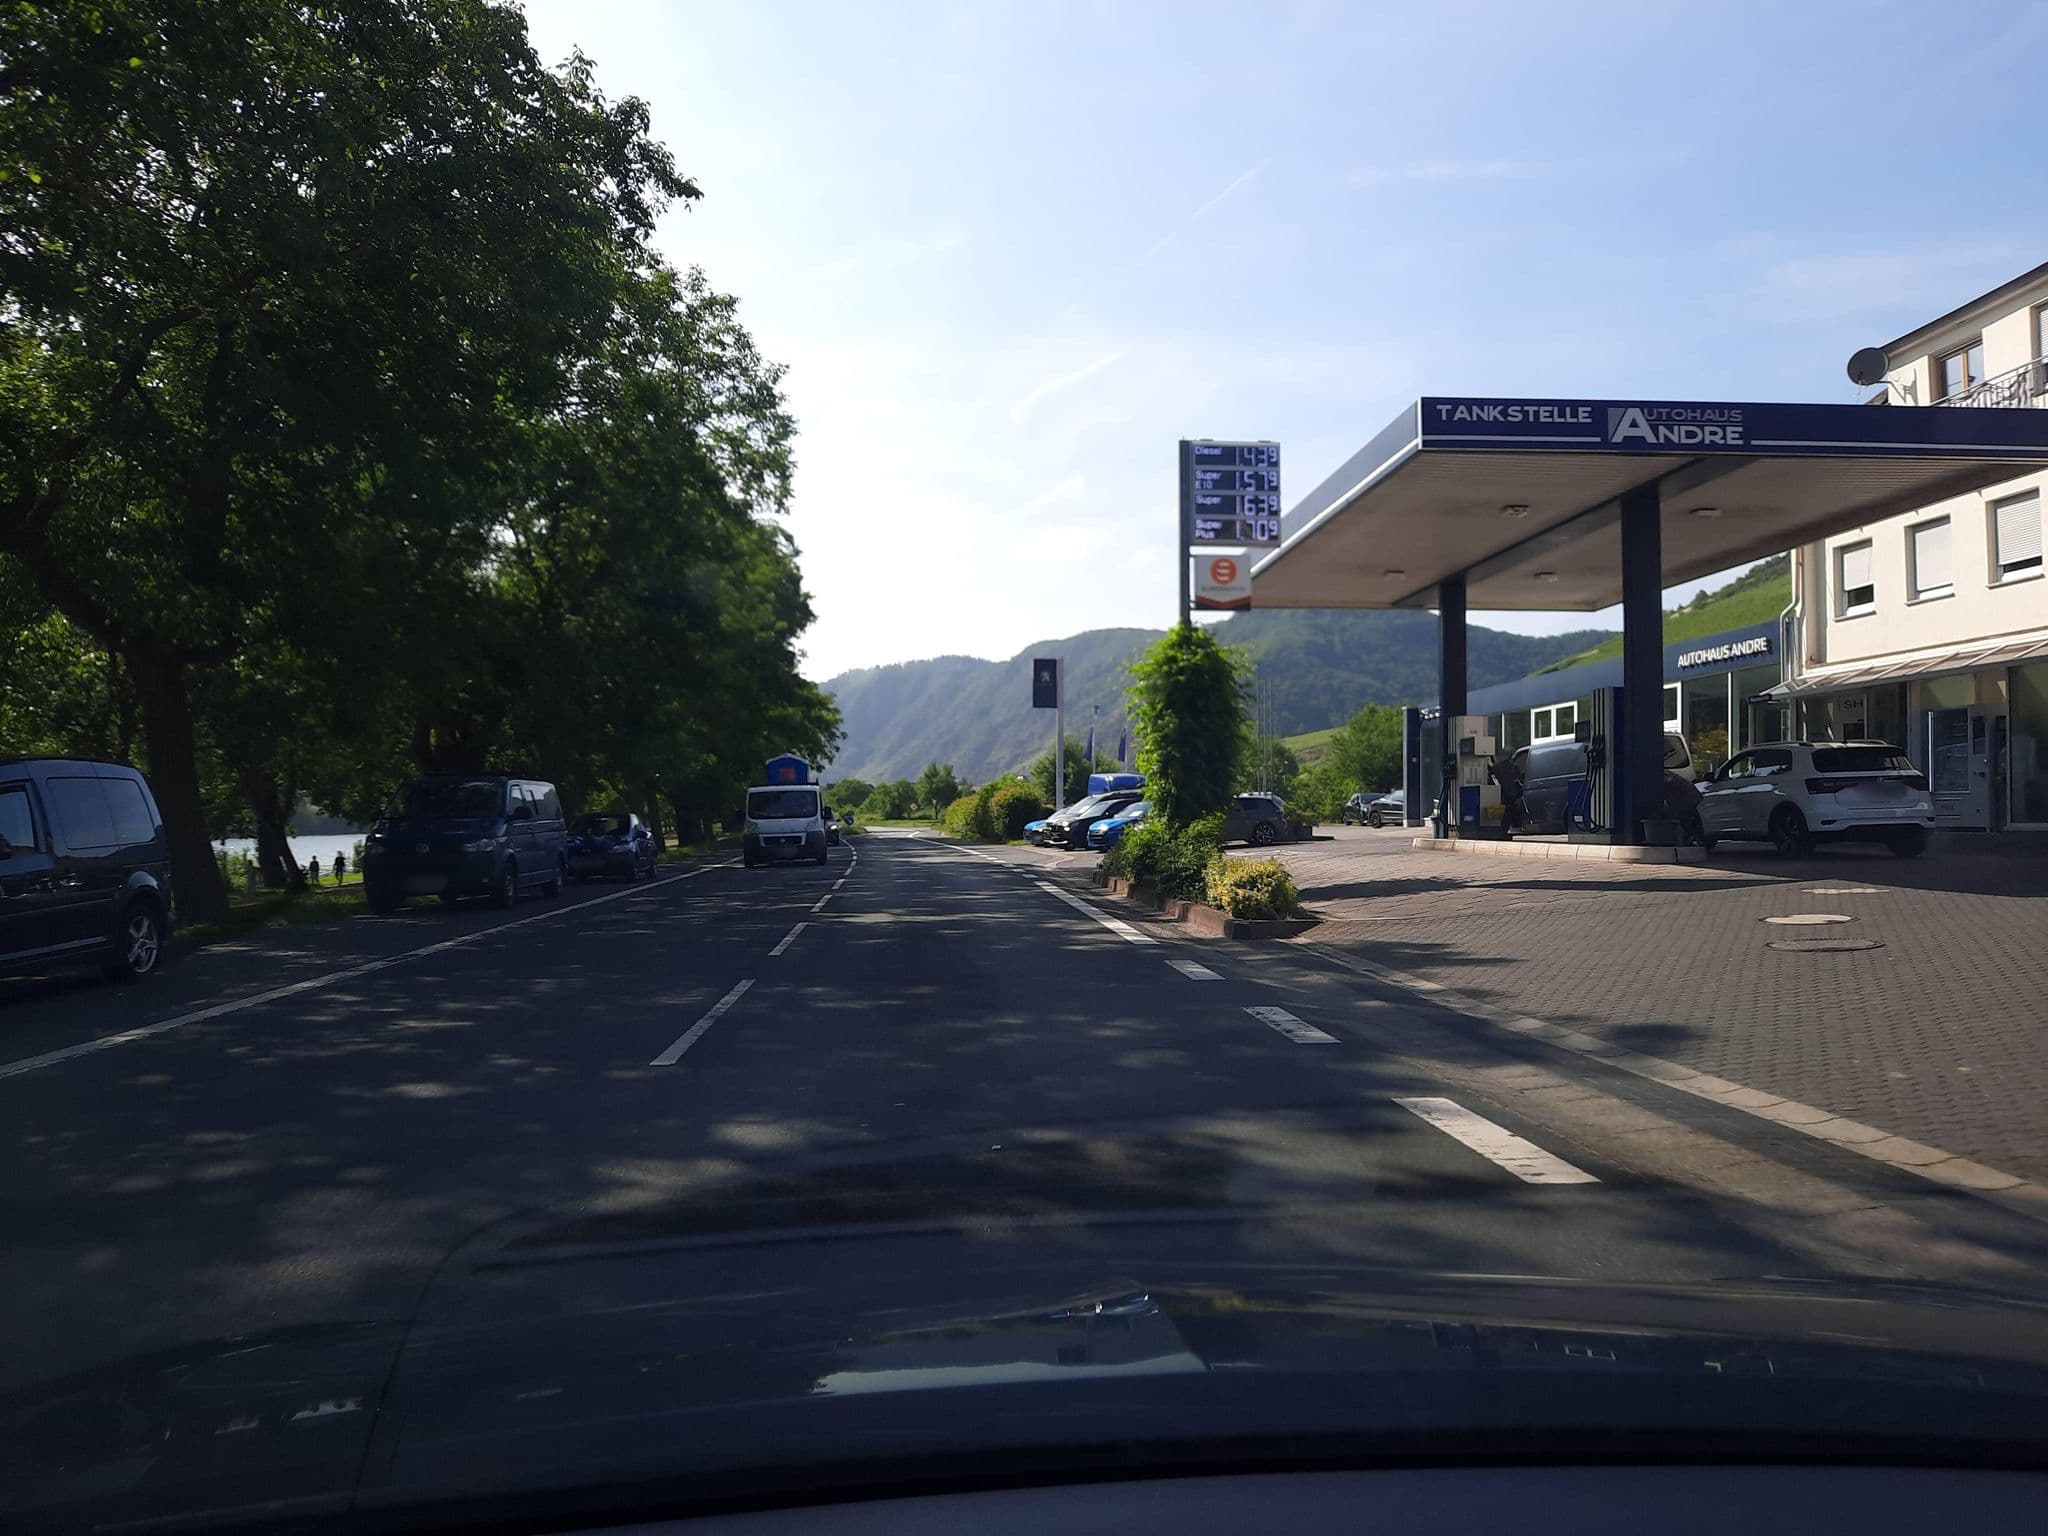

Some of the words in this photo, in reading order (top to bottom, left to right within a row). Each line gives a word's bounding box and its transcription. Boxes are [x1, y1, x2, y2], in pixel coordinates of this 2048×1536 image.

[1436, 404, 1593, 423] TANKSTELLE
[1611, 408, 1743, 445] ANDRE
[1195, 447, 1222, 456] Diesel
[1195, 471, 1222, 480] Super
[1195, 496, 1222, 505] Super
[1195, 521, 1222, 531] Super
[1195, 531, 1216, 540] Plus
[1677, 644, 1730, 667] AUTOHAUS
[1730, 637, 1767, 656] ANDRE
